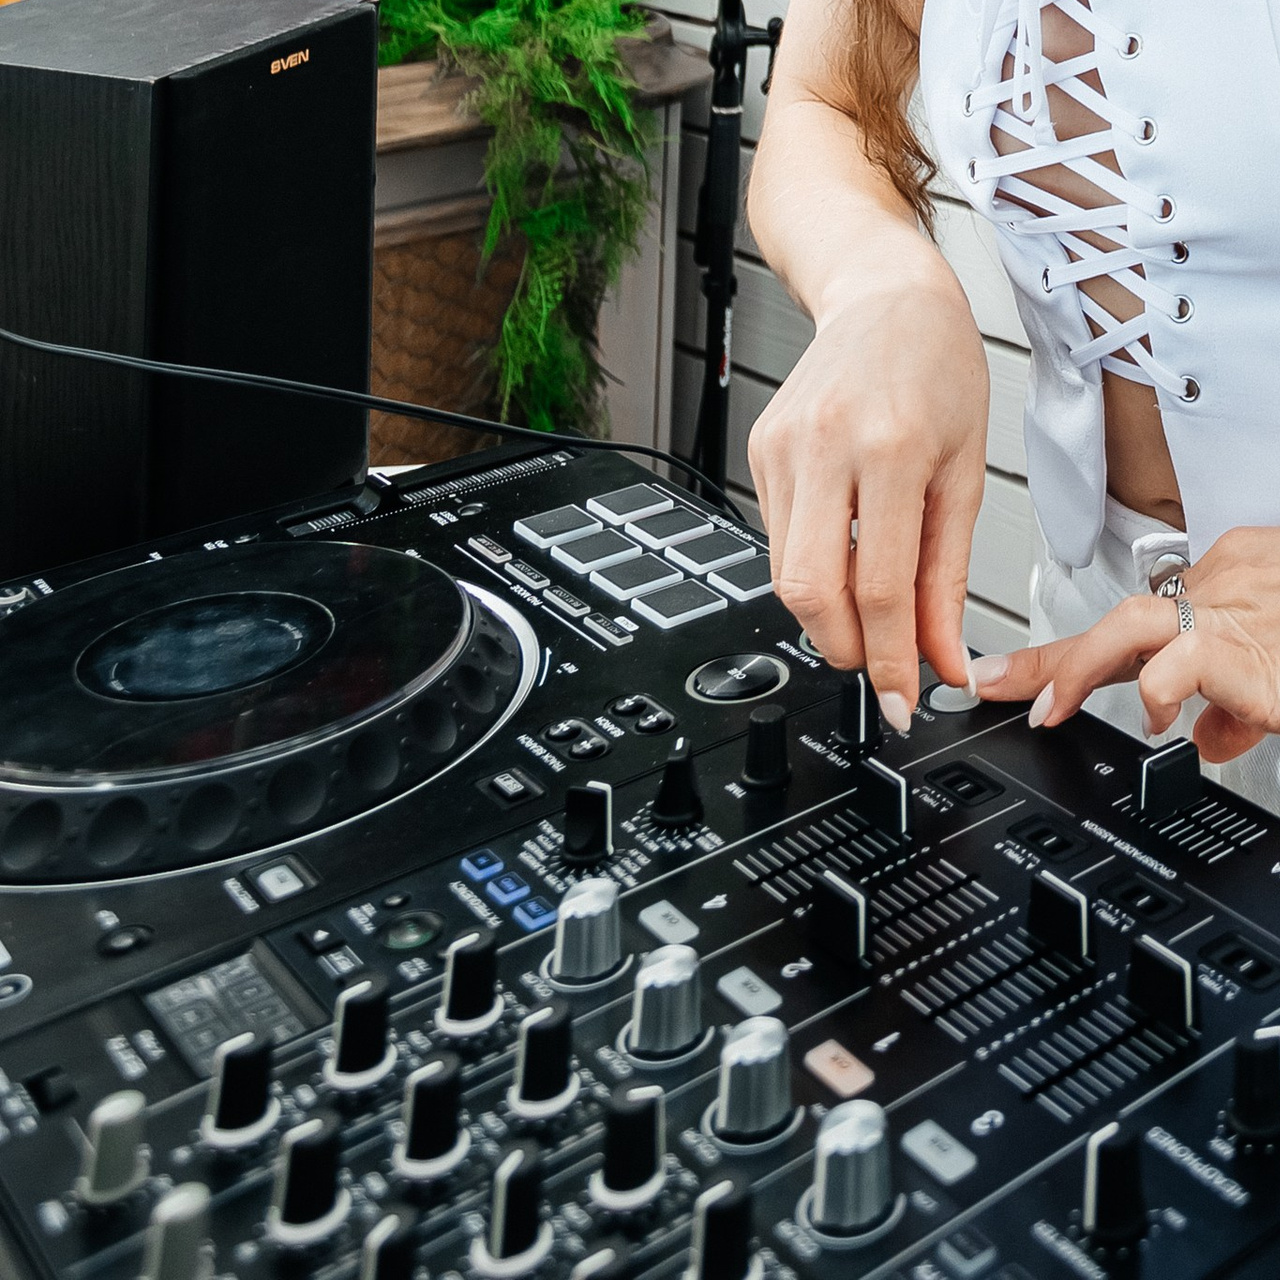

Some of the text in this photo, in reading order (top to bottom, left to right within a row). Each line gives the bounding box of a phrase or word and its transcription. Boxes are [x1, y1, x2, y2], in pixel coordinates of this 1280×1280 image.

[271, 48, 309, 74] SVEN
[509, 584, 542, 607] PAD MODE
[605, 624, 621, 636] HOT
[776, 640, 820, 668] PLAY/PAUSE
[562, 662, 578, 674] REV
[728, 666, 747, 680] CUE
[594, 715, 624, 737] SEARCH
[516, 733, 565, 772] TRACK SEARCH
[799, 733, 851, 769] LEVEL/DEPTH
[724, 782, 746, 799] TIME
[919, 793, 939, 809] THRU
[1002, 849, 1024, 864] THRU
[1081, 819, 1177, 880] CROSSFADER ASSIGN
[448, 880, 502, 929] FX FREQUENCY
[701, 893, 728, 910] 4
[660, 911, 680, 926] CUE
[780, 957, 813, 978] 2
[518, 971, 553, 1001] COLOR
[872, 1032, 900, 1052] 1
[971, 1110, 1005, 1135] 3
[1144, 1127, 1250, 1207] HEADPHONES
